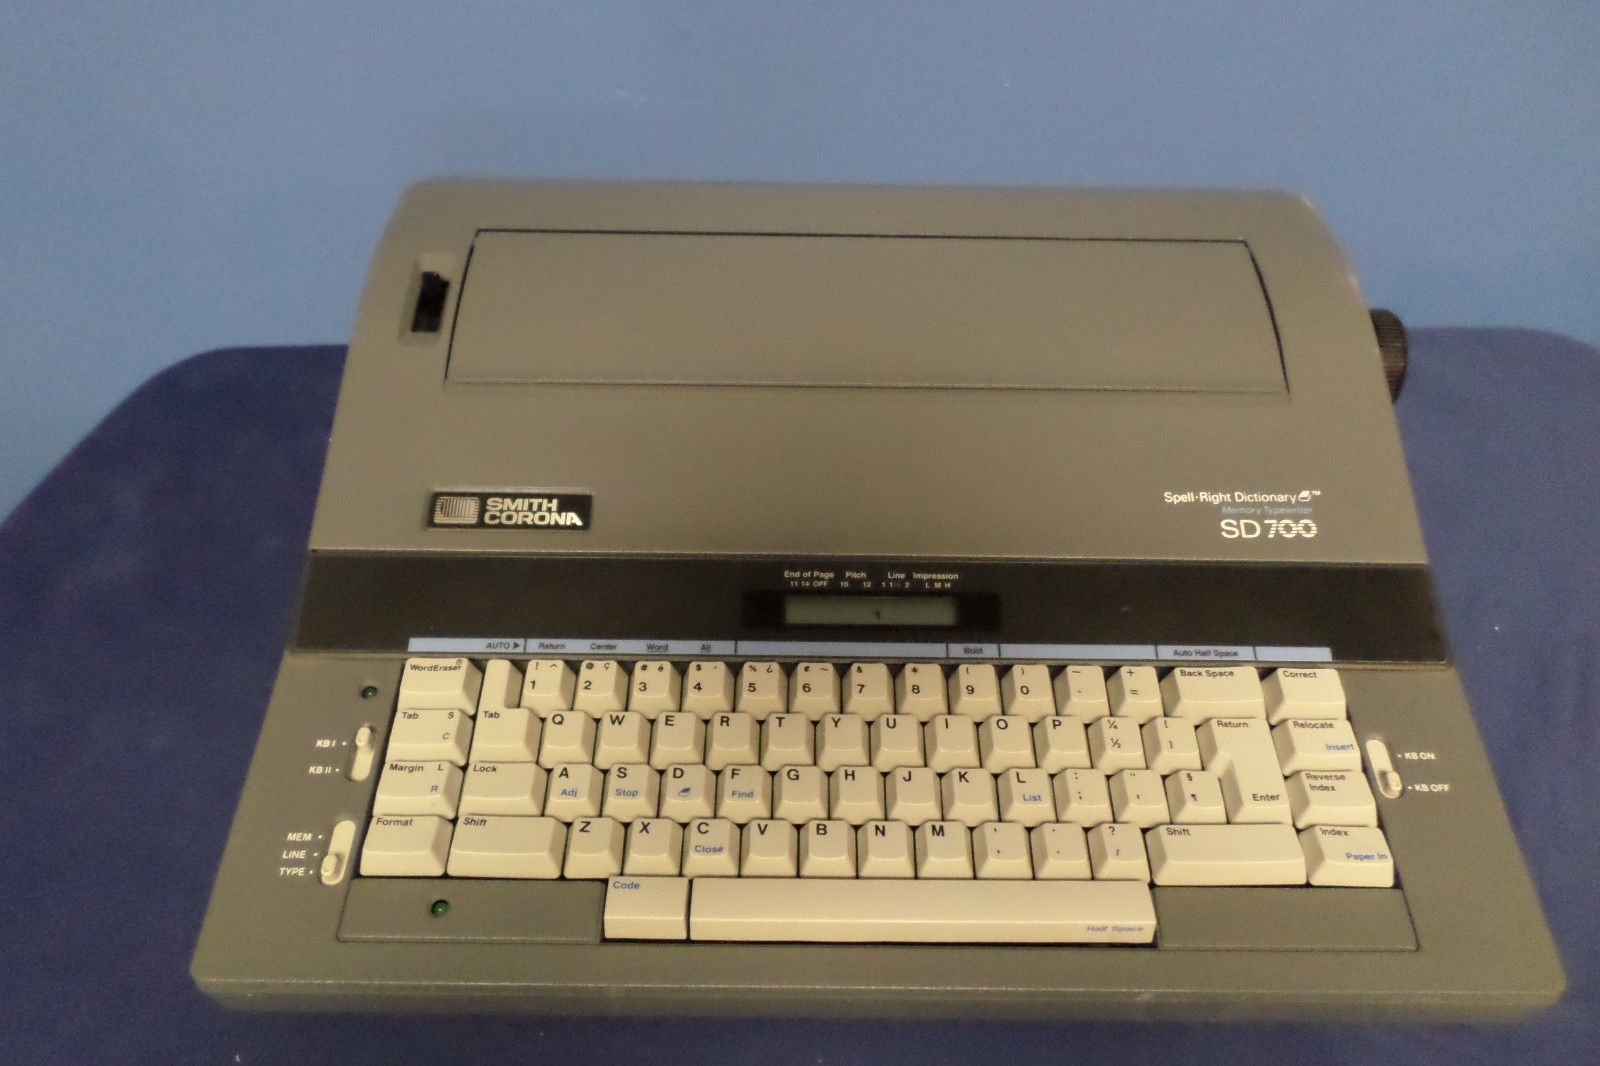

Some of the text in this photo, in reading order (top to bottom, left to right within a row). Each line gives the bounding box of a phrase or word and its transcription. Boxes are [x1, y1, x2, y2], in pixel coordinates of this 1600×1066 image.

[1234, 491, 1297, 504] Dictionary
[486, 497, 558, 512] SMITH
[1221, 505, 1313, 516] Memory Typewriter
[484, 511, 583, 526] CORONA
[1220, 519, 1318, 539] SD 700
[784, 571, 834, 580] End of Page
[845, 571, 867, 580] Pitch
[887, 572, 906, 580] Line
[913, 572, 959, 581] Impression
[486, 642, 511, 650] AUTO
[590, 643, 618, 651] Center
[646, 643, 668, 652] Word
[700, 644, 711, 653] All
[964, 646, 983, 655] Bold
[1173, 649, 1239, 659] Auto Half Space
[1179, 670, 1235, 680] Back Space
[1282, 671, 1318, 679] Correct
[529, 680, 536, 690] 1
[583, 680, 592, 690] 2
[638, 682, 648, 692] 3
[693, 682, 702, 692] 4
[748, 683, 757, 693] 5
[802, 683, 811, 693] 6
[857, 684, 865, 694] 7
[911, 684, 920, 694] 8
[965, 685, 975, 695] 9
[402, 711, 454, 720] Tab S
[483, 711, 500, 719] Tab
[552, 713, 564, 726] Q
[609, 714, 626, 726] W
[664, 714, 675, 727] E
[719, 715, 731, 727] R
[775, 716, 786, 728] T
[831, 717, 842, 729] Y
[886, 717, 897, 729] U
[996, 718, 1009, 730] O
[1052, 719, 1062, 730] P
[1217, 720, 1249, 729] Return
[1293, 721, 1335, 730] Relocate
[442, 732, 450, 741] C
[316, 739, 330, 748] KB
[1325, 743, 1355, 751] Insert
[1404, 752, 1436, 760] KB ON
[308, 766, 323, 774] KB
[389, 763, 424, 773] Margin
[473, 764, 497, 773] Lock
[558, 767, 569, 779] A
[616, 767, 627, 779] S
[672, 768, 684, 779] D
[730, 768, 741, 780] F
[786, 769, 799, 781] G
[844, 770, 855, 781] H
[903, 771, 912, 782] J
[958, 771, 969, 783] K
[1016, 772, 1026, 784] L
[1306, 772, 1346, 781] Reverse
[560, 788, 578, 798] Adj
[615, 788, 639, 798] Stop
[1309, 784, 1337, 792] Index
[1414, 784, 1450, 792] KB OFF
[731, 790, 754, 798] Find
[1022, 793, 1042, 802] List
[1252, 793, 1280, 801] Enter
[376, 817, 413, 826] Format
[463, 817, 487, 826] Shift
[579, 821, 592, 833] Z
[639, 822, 651, 834] X
[697, 822, 710, 834] C
[757, 824, 768, 835] V
[816, 824, 828, 835] B
[875, 825, 887, 836] N
[931, 825, 945, 837] M
[1166, 827, 1191, 836] Shift
[1320, 828, 1350, 836] Index
[287, 833, 312, 841] MEM
[694, 845, 724, 853] Close
[283, 851, 306, 859] LINE
[1346, 853, 1375, 861] Paper
[280, 868, 305, 876] TYPE
[613, 881, 640, 890] Code
[1112, 925, 1144, 933] Space
